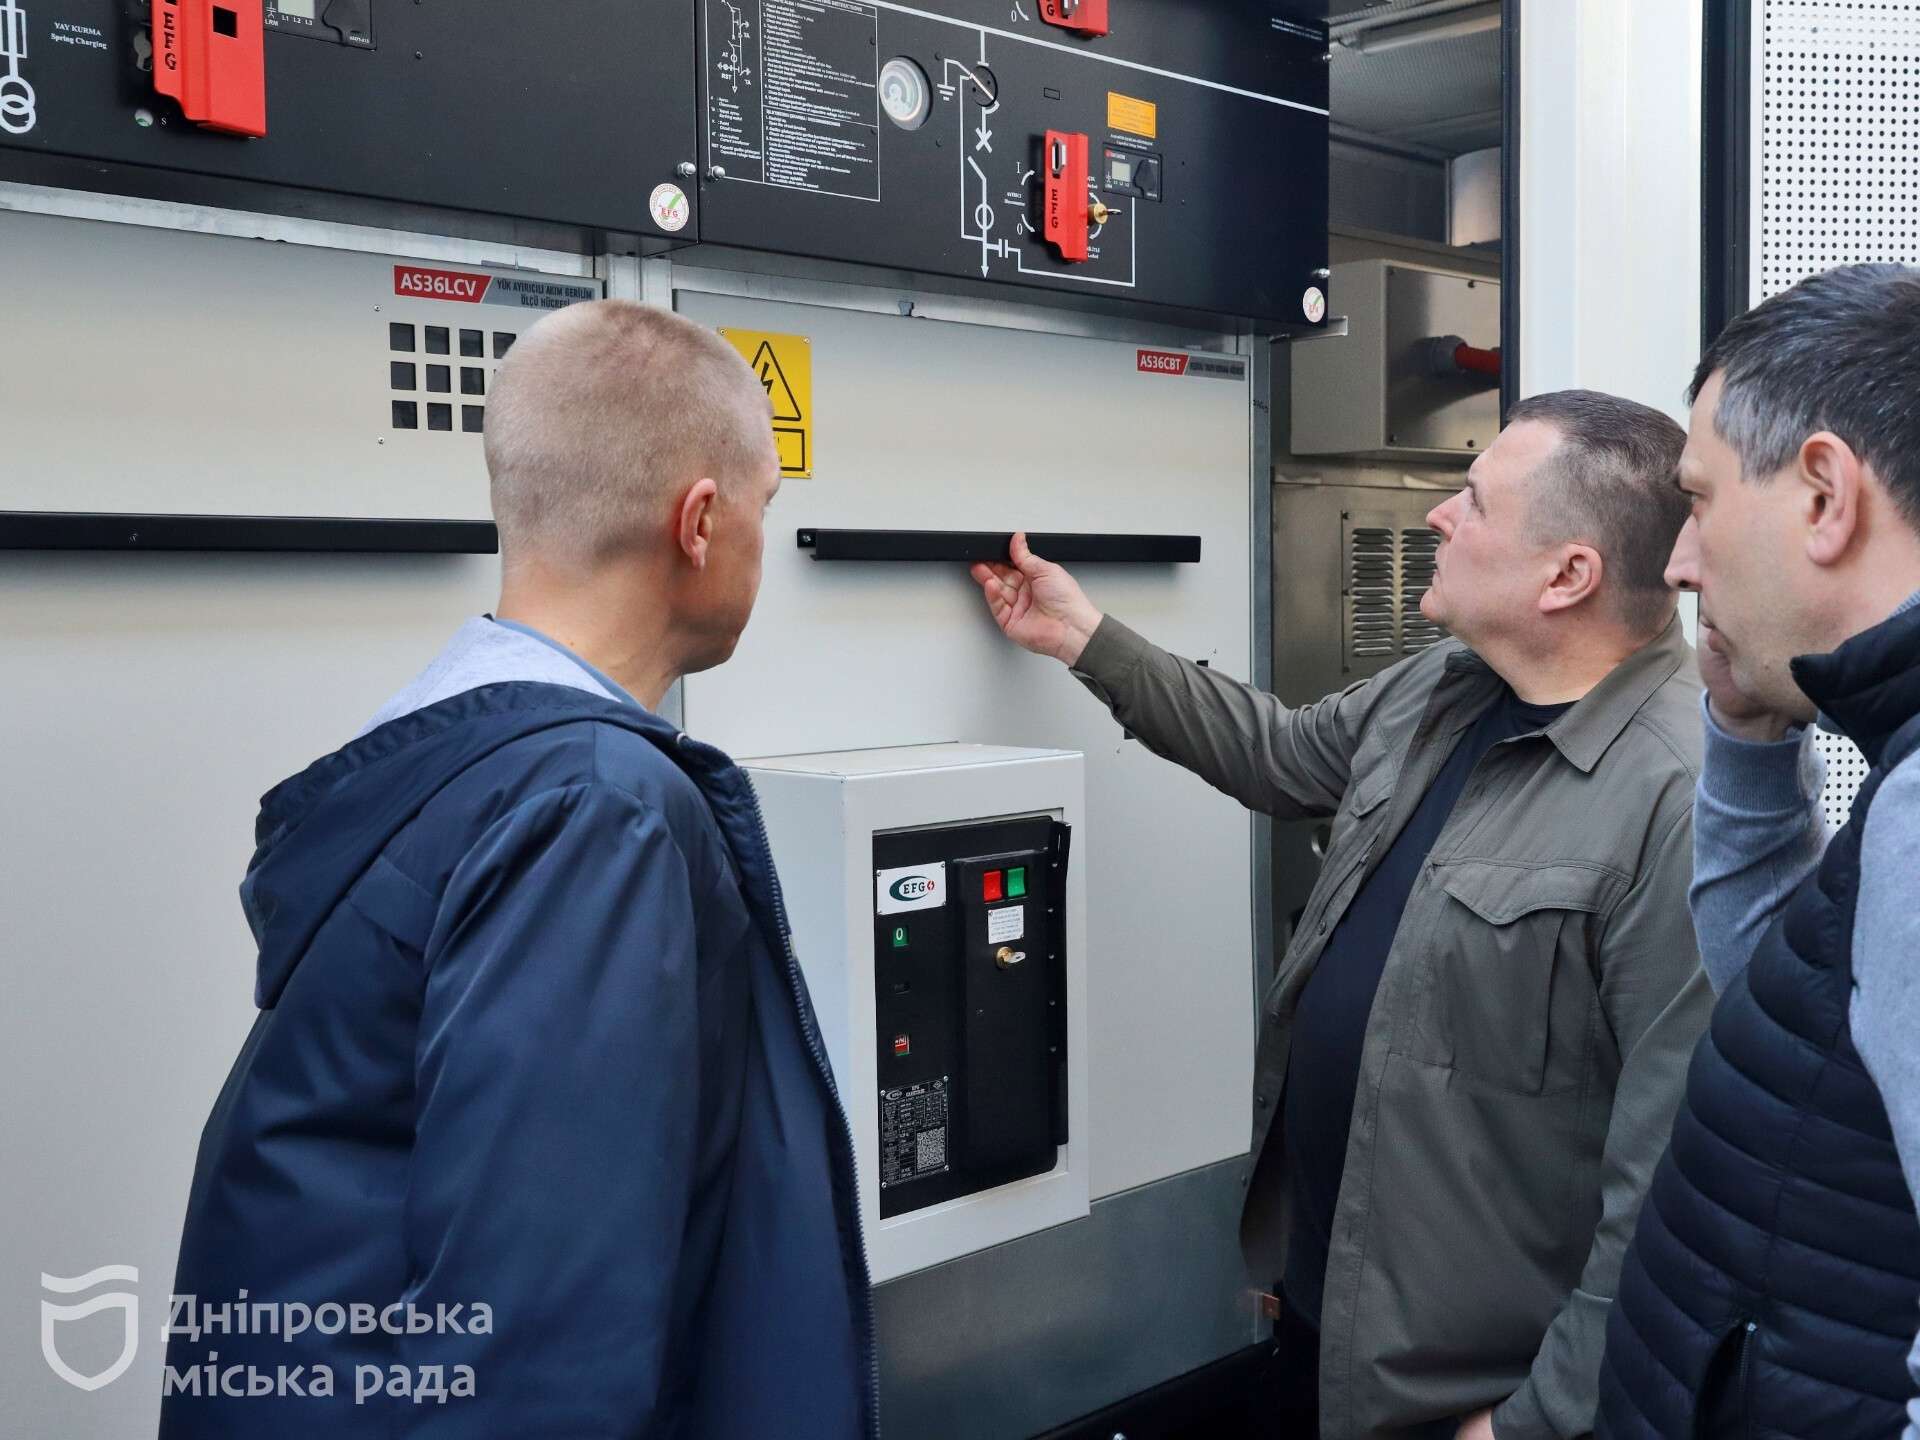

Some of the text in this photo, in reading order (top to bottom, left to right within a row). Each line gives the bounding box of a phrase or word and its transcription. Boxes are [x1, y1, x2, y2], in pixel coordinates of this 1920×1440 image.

[54, 22, 102, 36] YAY KURMA
[50, 33, 108, 50] Spring Charging
[163, 11, 177, 70] EFG
[1051, 188, 1059, 229] EFG
[400, 272, 478, 296] AS36LCV
[1140, 354, 1181, 371] AS36CBT
[903, 881, 926, 895] EFG
